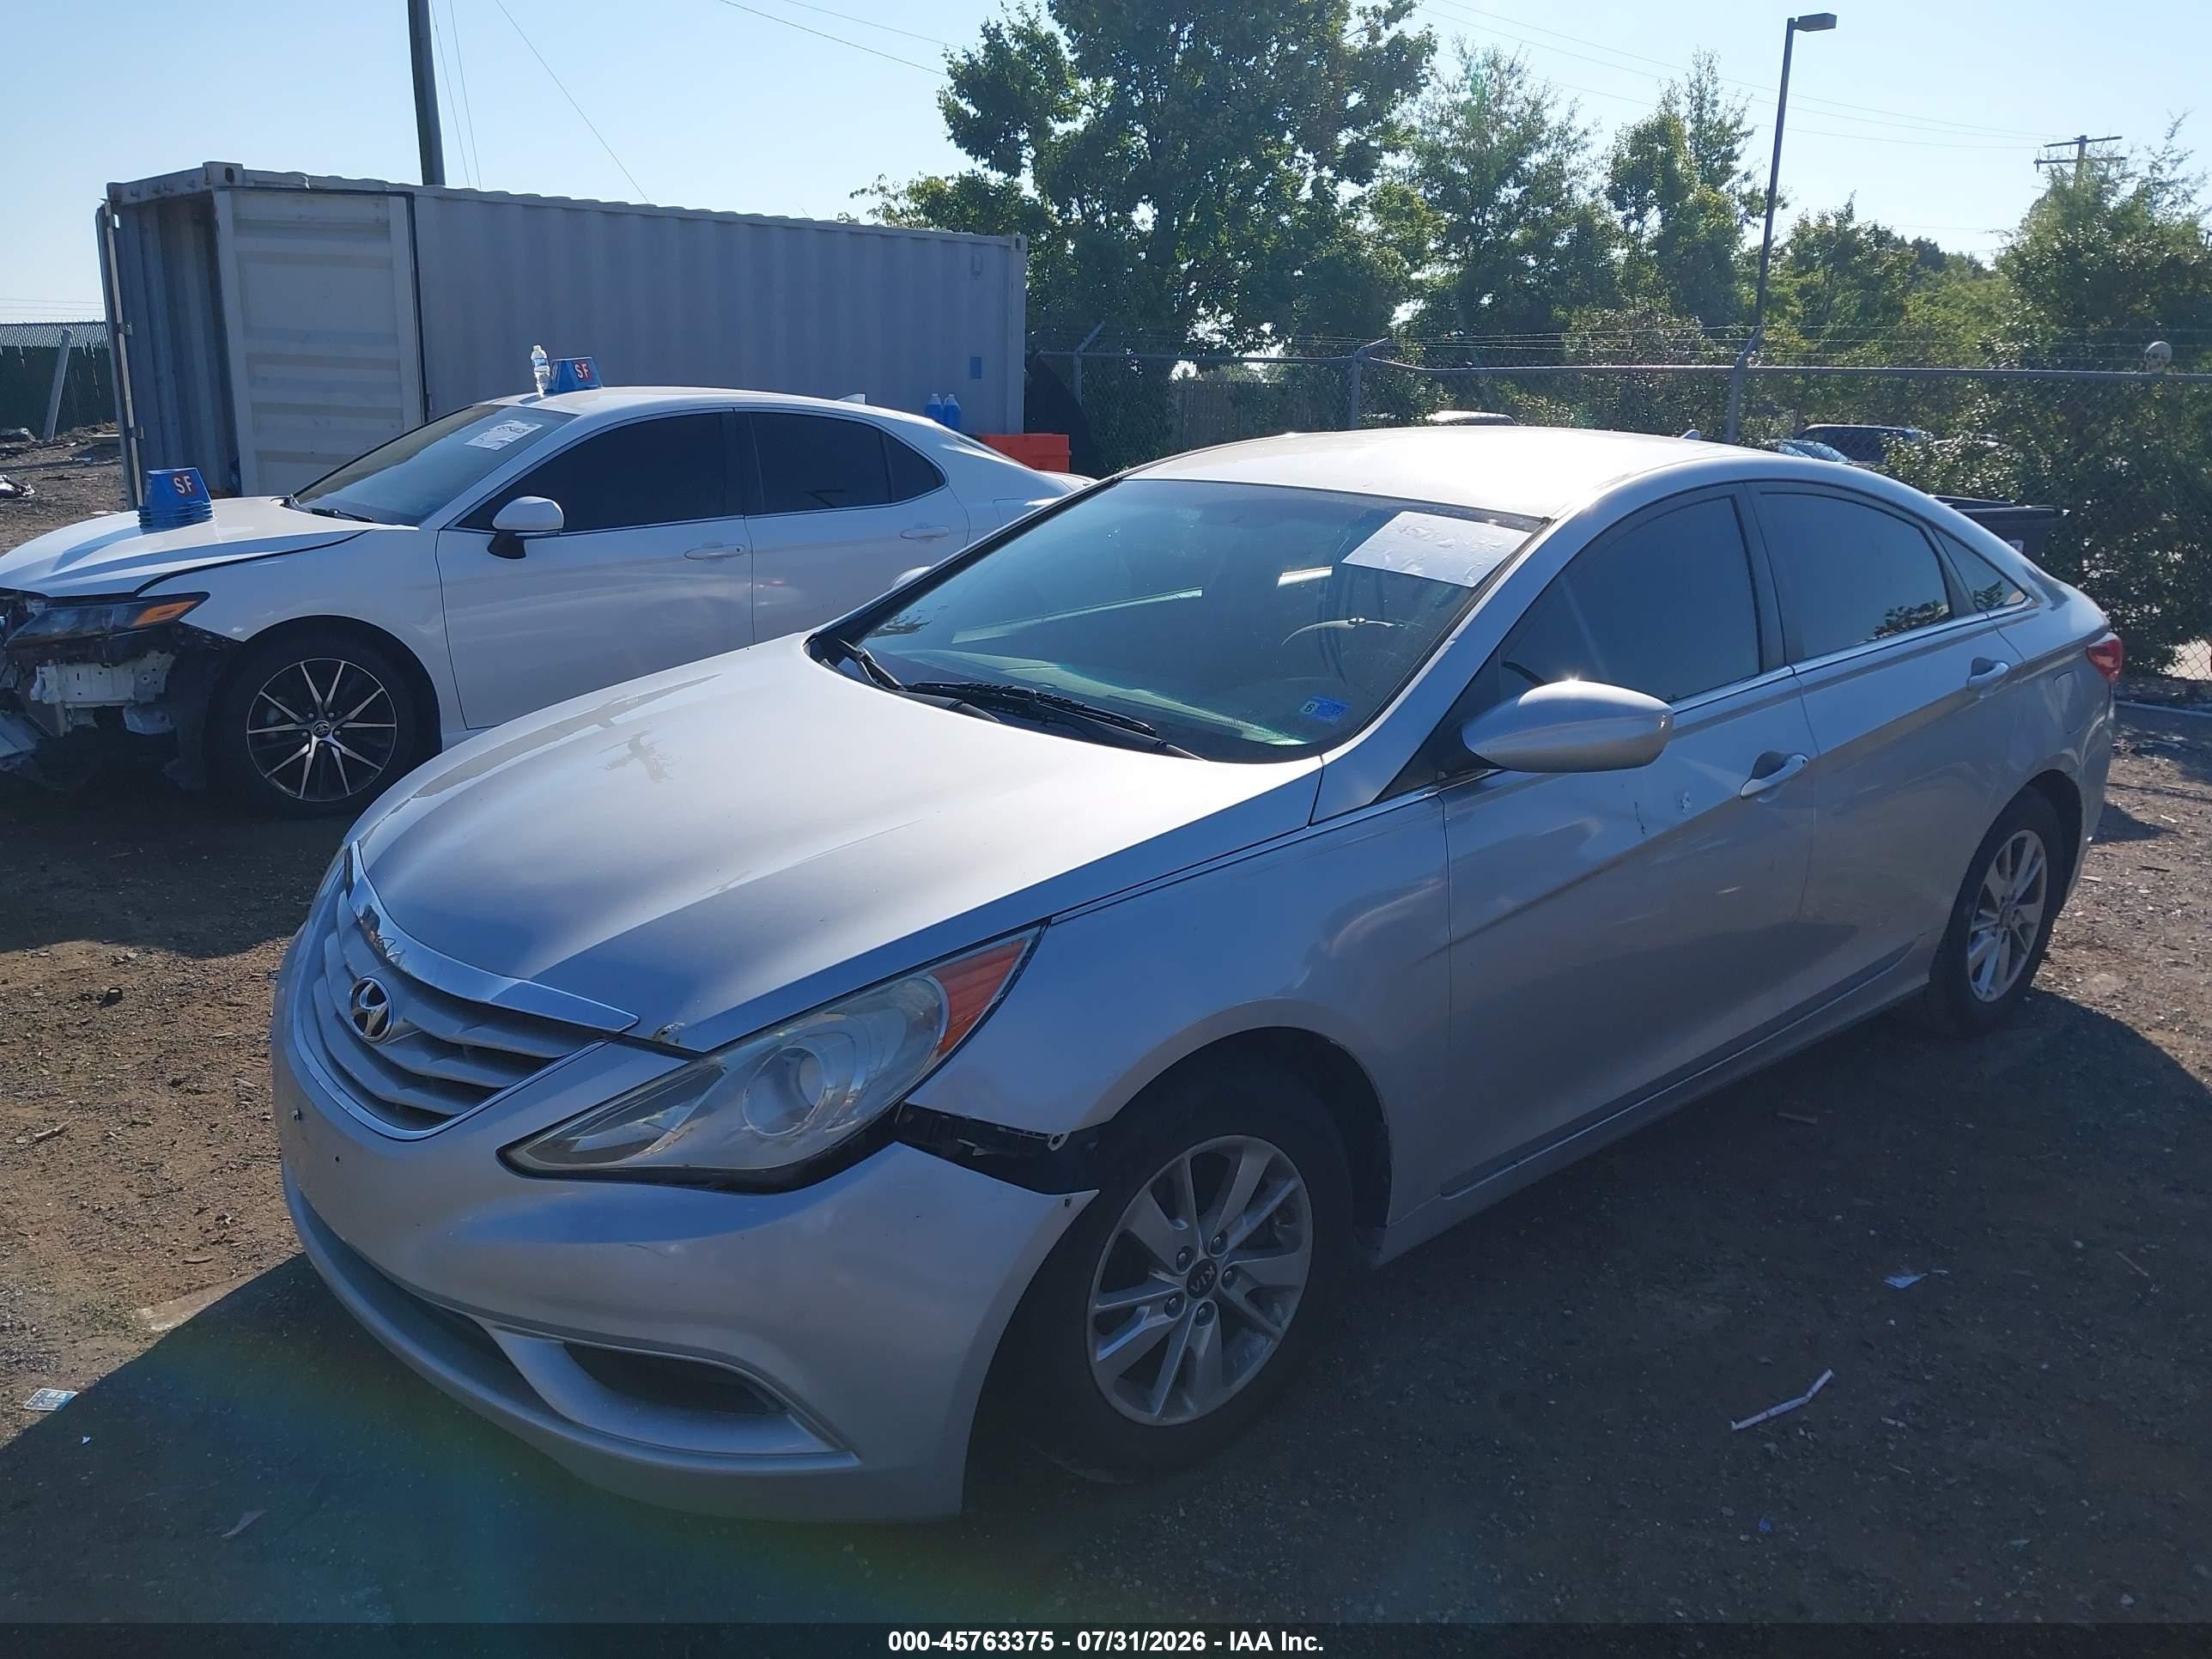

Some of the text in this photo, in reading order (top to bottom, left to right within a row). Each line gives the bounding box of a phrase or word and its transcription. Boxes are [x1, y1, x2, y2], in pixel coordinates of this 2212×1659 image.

[574, 363, 590, 379] SF
[173, 475, 192, 495] SF
[1304, 703, 1316, 713] 6
[1190, 1265, 1216, 1292] KIA
